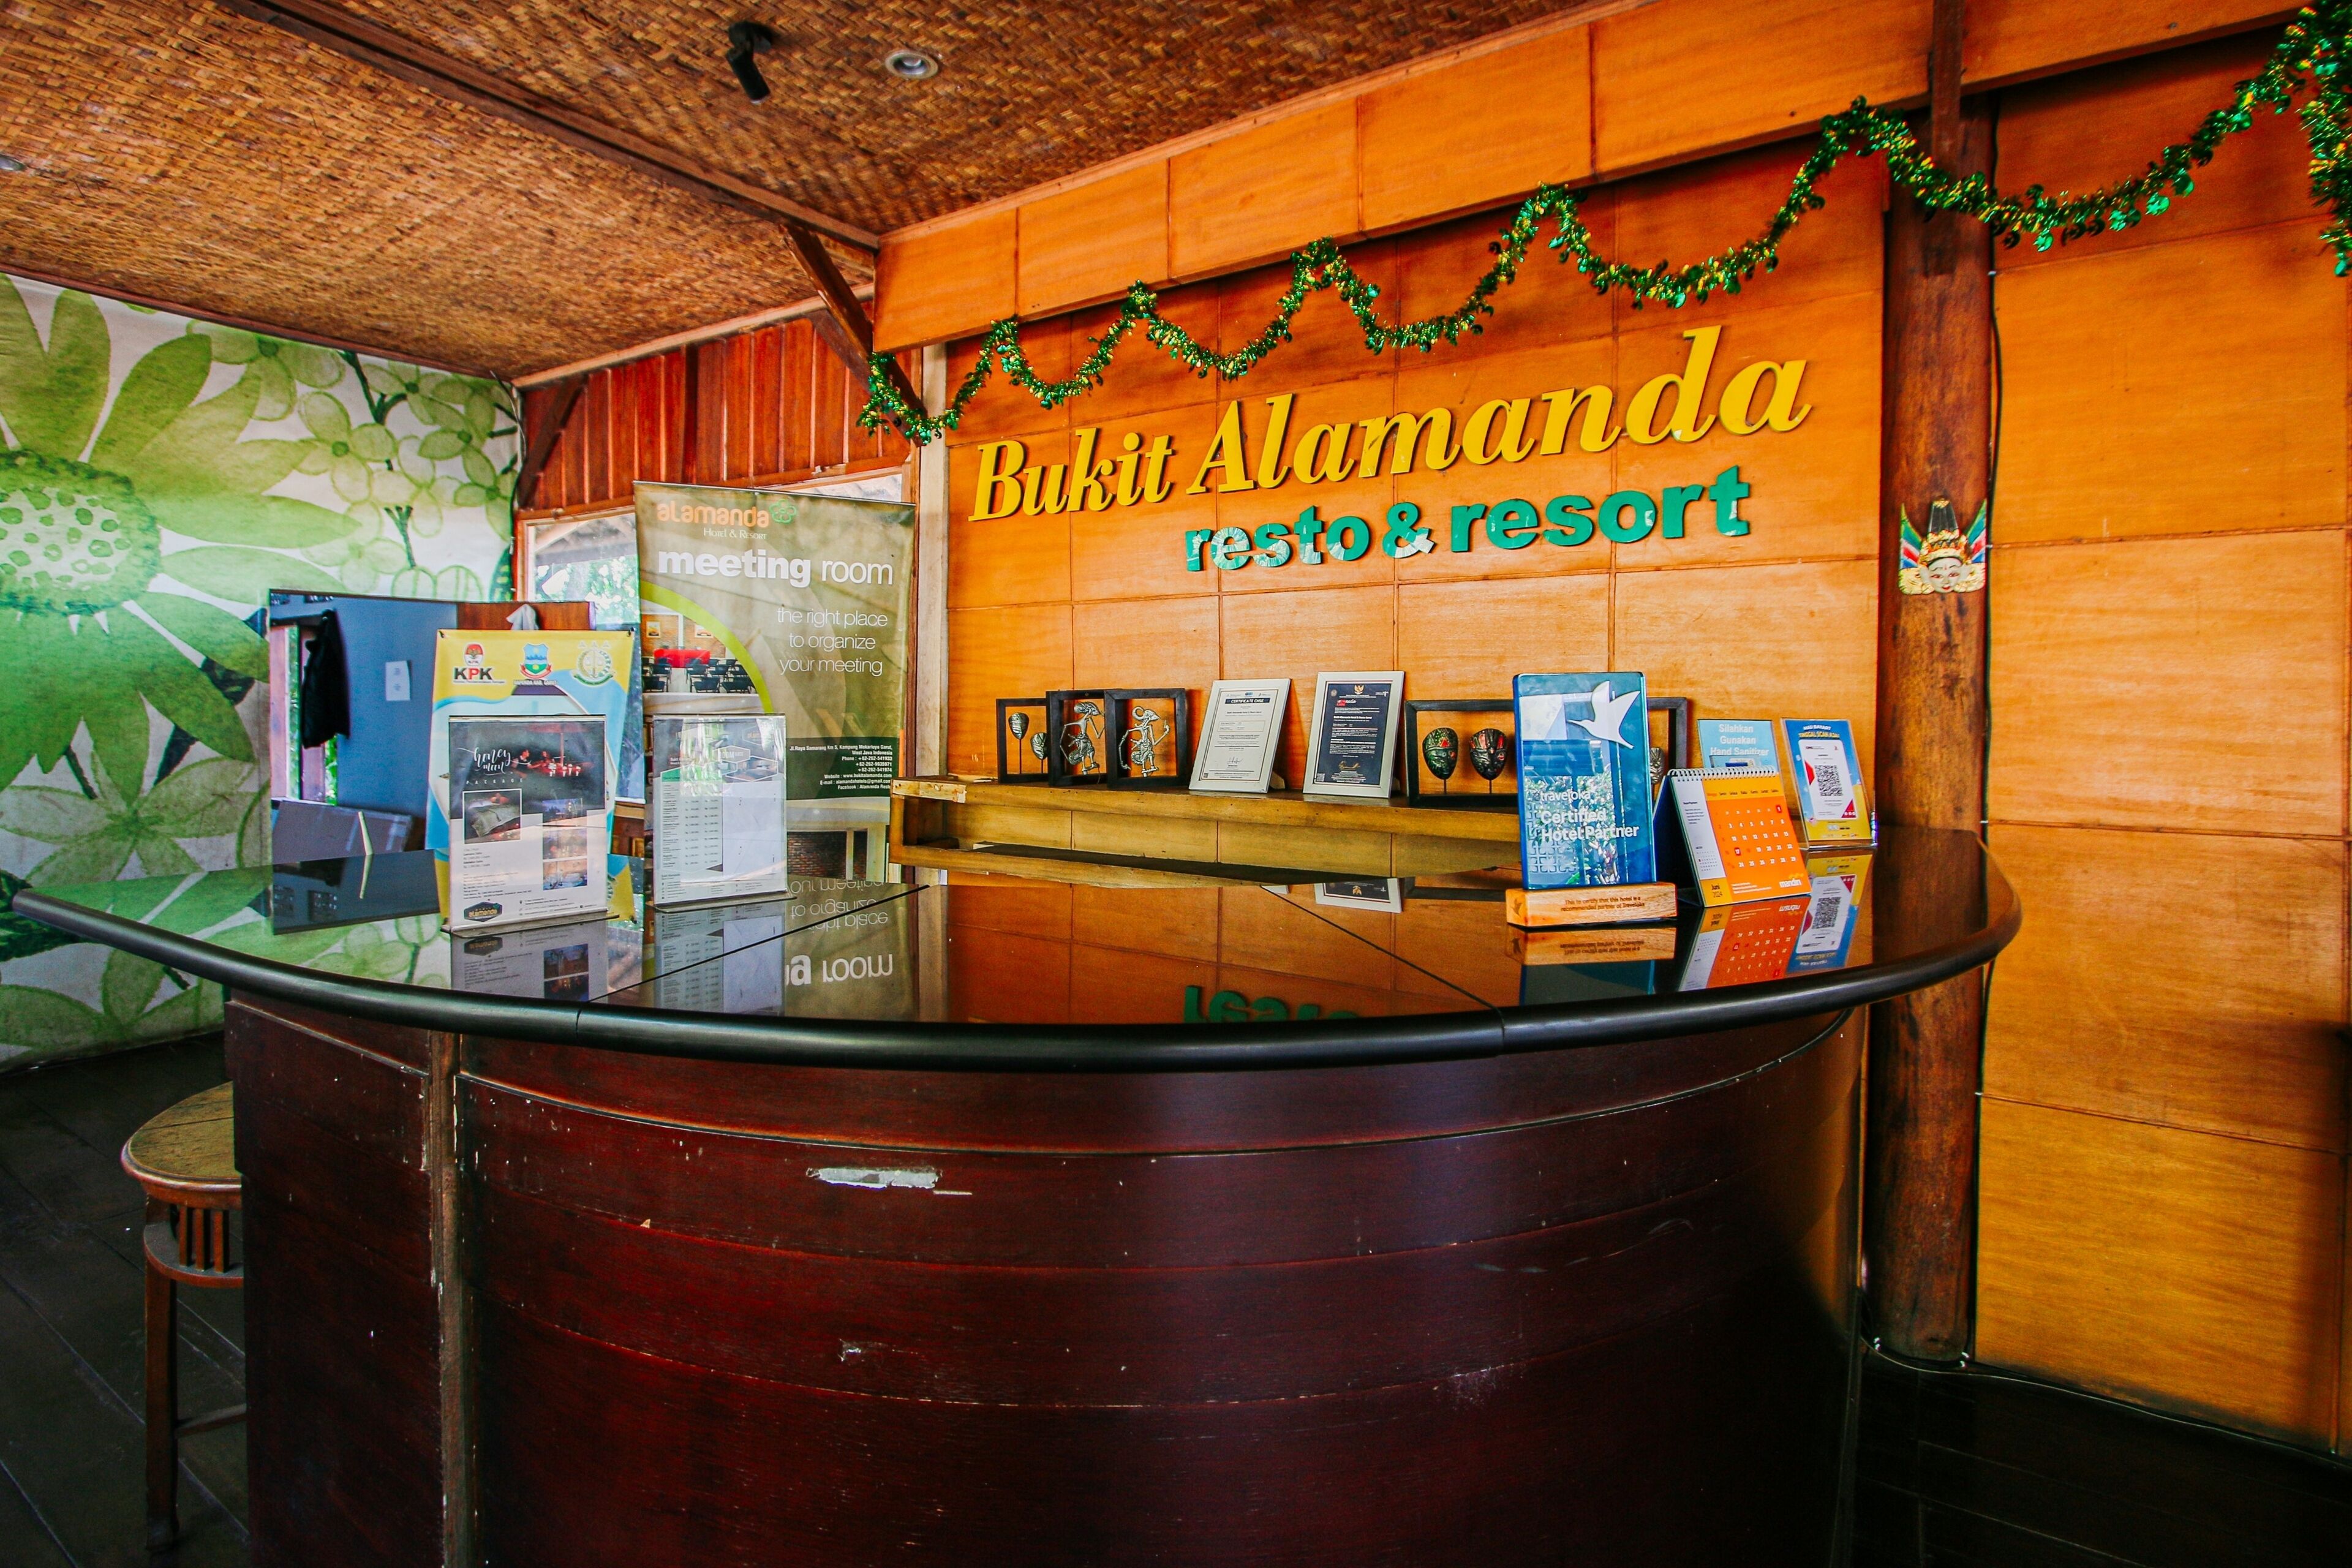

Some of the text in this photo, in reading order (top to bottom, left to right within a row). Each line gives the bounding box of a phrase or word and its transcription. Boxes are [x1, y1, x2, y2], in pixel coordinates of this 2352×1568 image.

[968, 325, 1812, 522] Bukit Alamanda
[1186, 465, 1751, 572] resto & resort
[729, 529, 737, 538] &
[658, 549, 893, 588] meeting room
[777, 607, 888, 628] the right place
[789, 633, 876, 652] to organize
[454, 667, 493, 680] KPK
[779, 657, 883, 677] your meeting
[1718, 724, 1754, 733] Silahkan
[1720, 736, 1756, 745] Gunakan
[1710, 747, 1770, 756] Hand Sanitizer
[1540, 789, 1591, 802] traveloka
[1540, 808, 1607, 824] Certified
[1541, 826, 1640, 842] Hotel Partner
